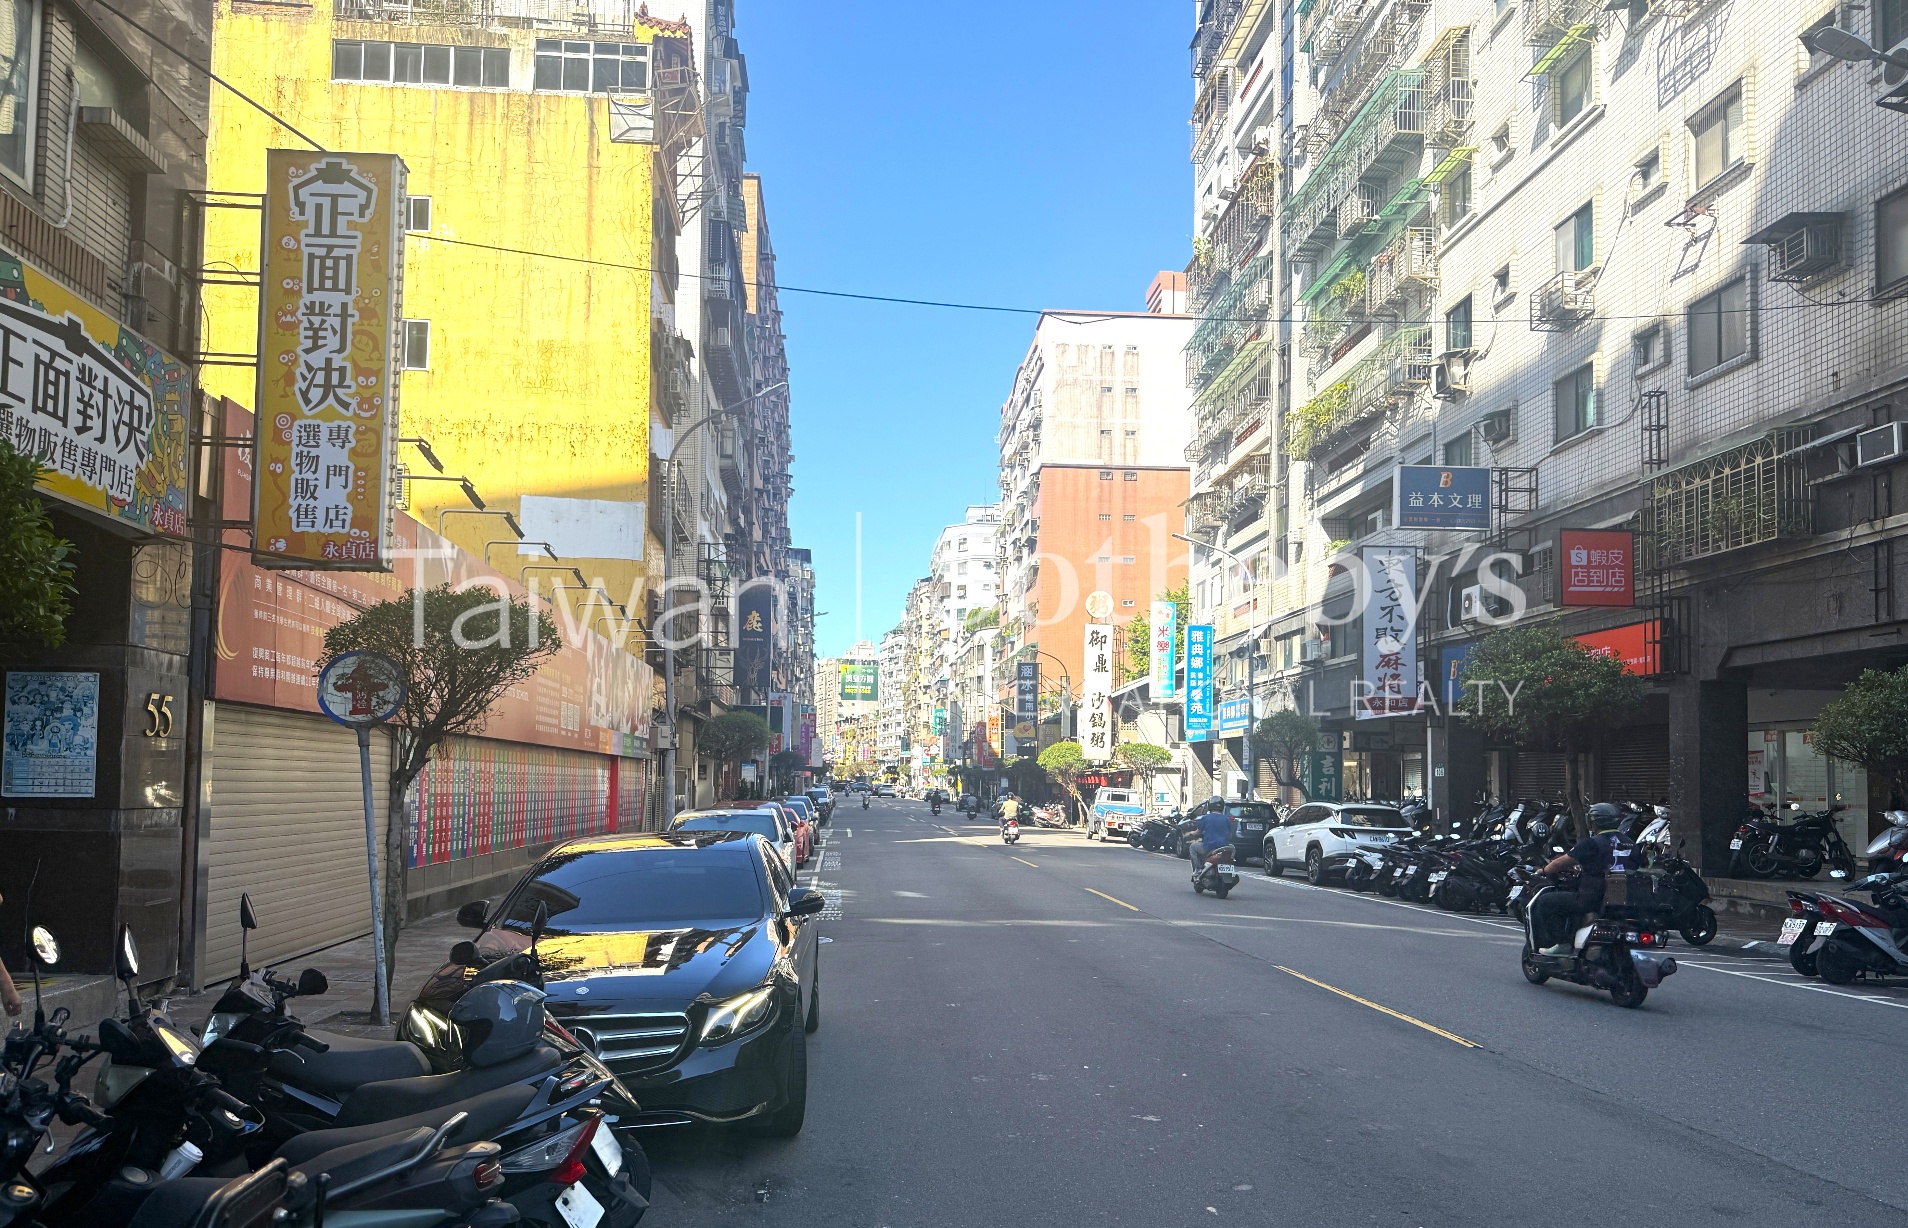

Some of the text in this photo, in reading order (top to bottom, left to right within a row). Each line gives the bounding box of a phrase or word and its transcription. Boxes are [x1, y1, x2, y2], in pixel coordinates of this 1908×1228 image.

[299, 193, 358, 413] 正面對決
[0, 326, 147, 465] 正面對決
[293, 423, 322, 529] 選物販售
[322, 424, 352, 530] 專門店
[152, 502, 185, 535] 永貞店
[1408, 491, 1482, 509] 益本文理
[323, 541, 375, 560] 永貞店
[1590, 549, 1625, 566] 蝦皮
[1571, 567, 1625, 586] 店到店
[1374, 549, 1408, 648] 東方不敗
[742, 609, 763, 632] 鹿
[1089, 629, 1109, 673] 御鼎
[1190, 630, 1204, 669] 雅典娜
[1020, 665, 1033, 691] 涵冰
[1375, 651, 1408, 695] 麻將
[145, 693, 174, 737] 55
[1089, 692, 1106, 749] 沙鍋粥
[1372, 697, 1409, 708] 永和店
[1318, 754, 1337, 797] 吉利
